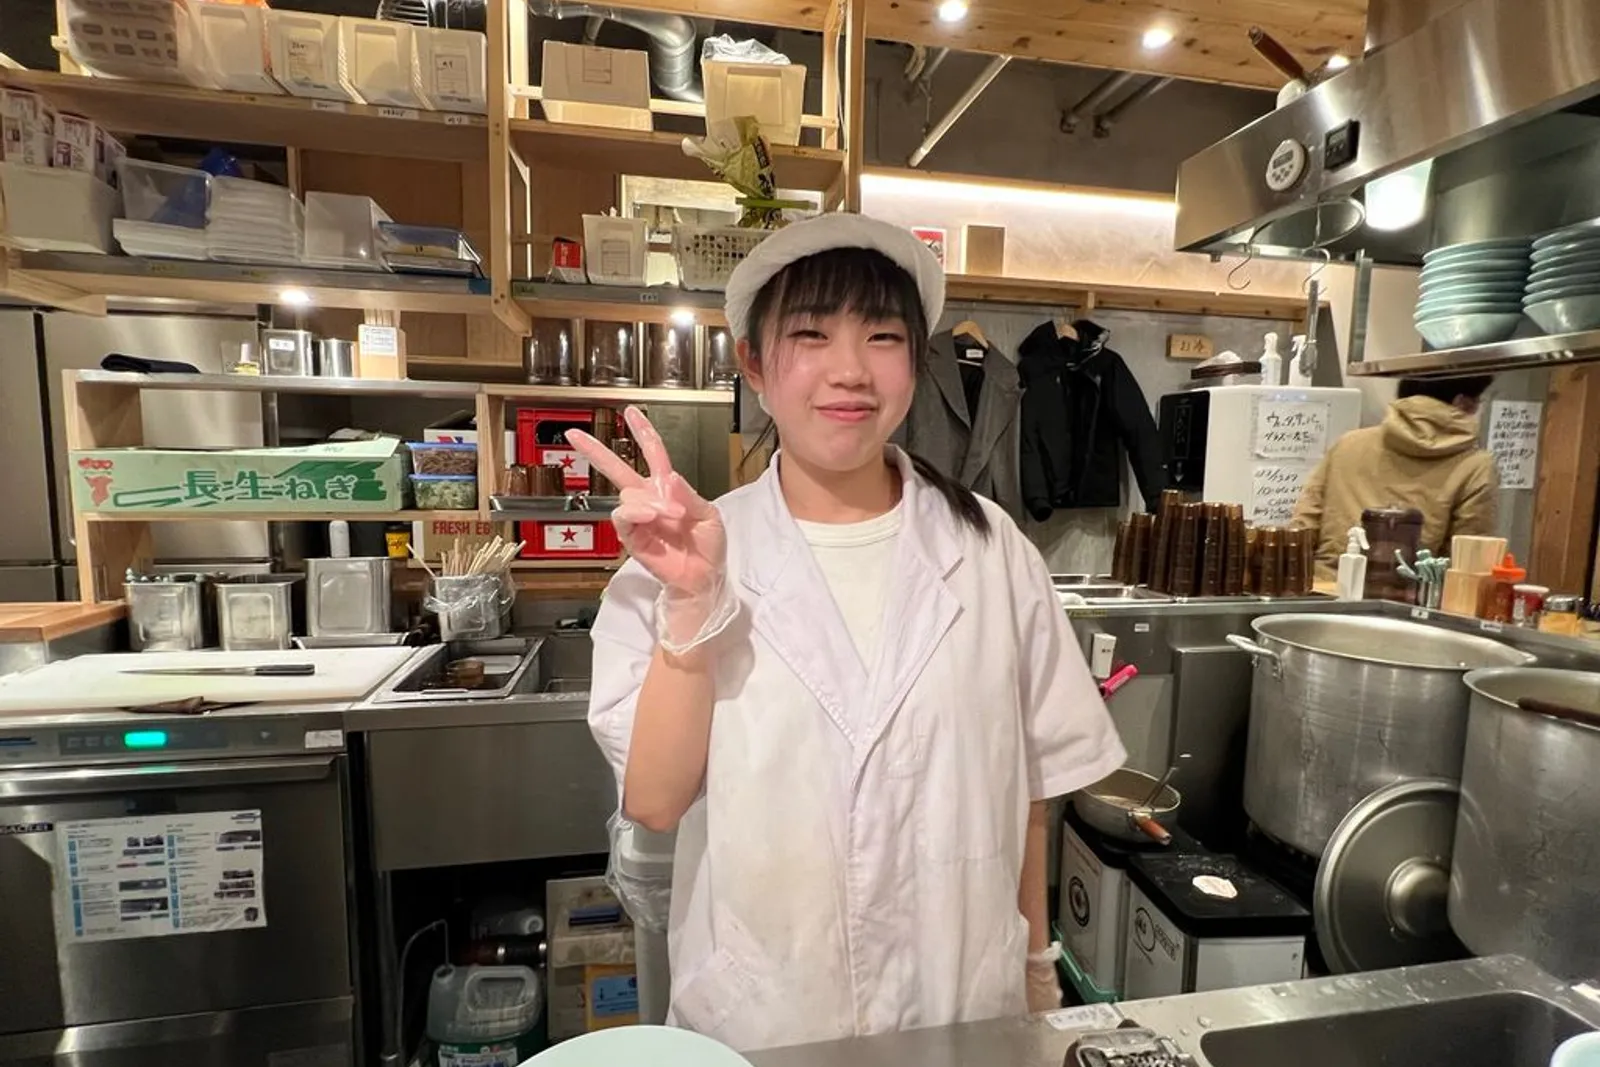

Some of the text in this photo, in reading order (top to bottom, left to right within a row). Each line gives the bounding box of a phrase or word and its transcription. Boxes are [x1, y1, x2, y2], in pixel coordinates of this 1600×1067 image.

[184, 470, 356, 502] 長生ねぎ
[432, 521, 470, 535] FRESH
